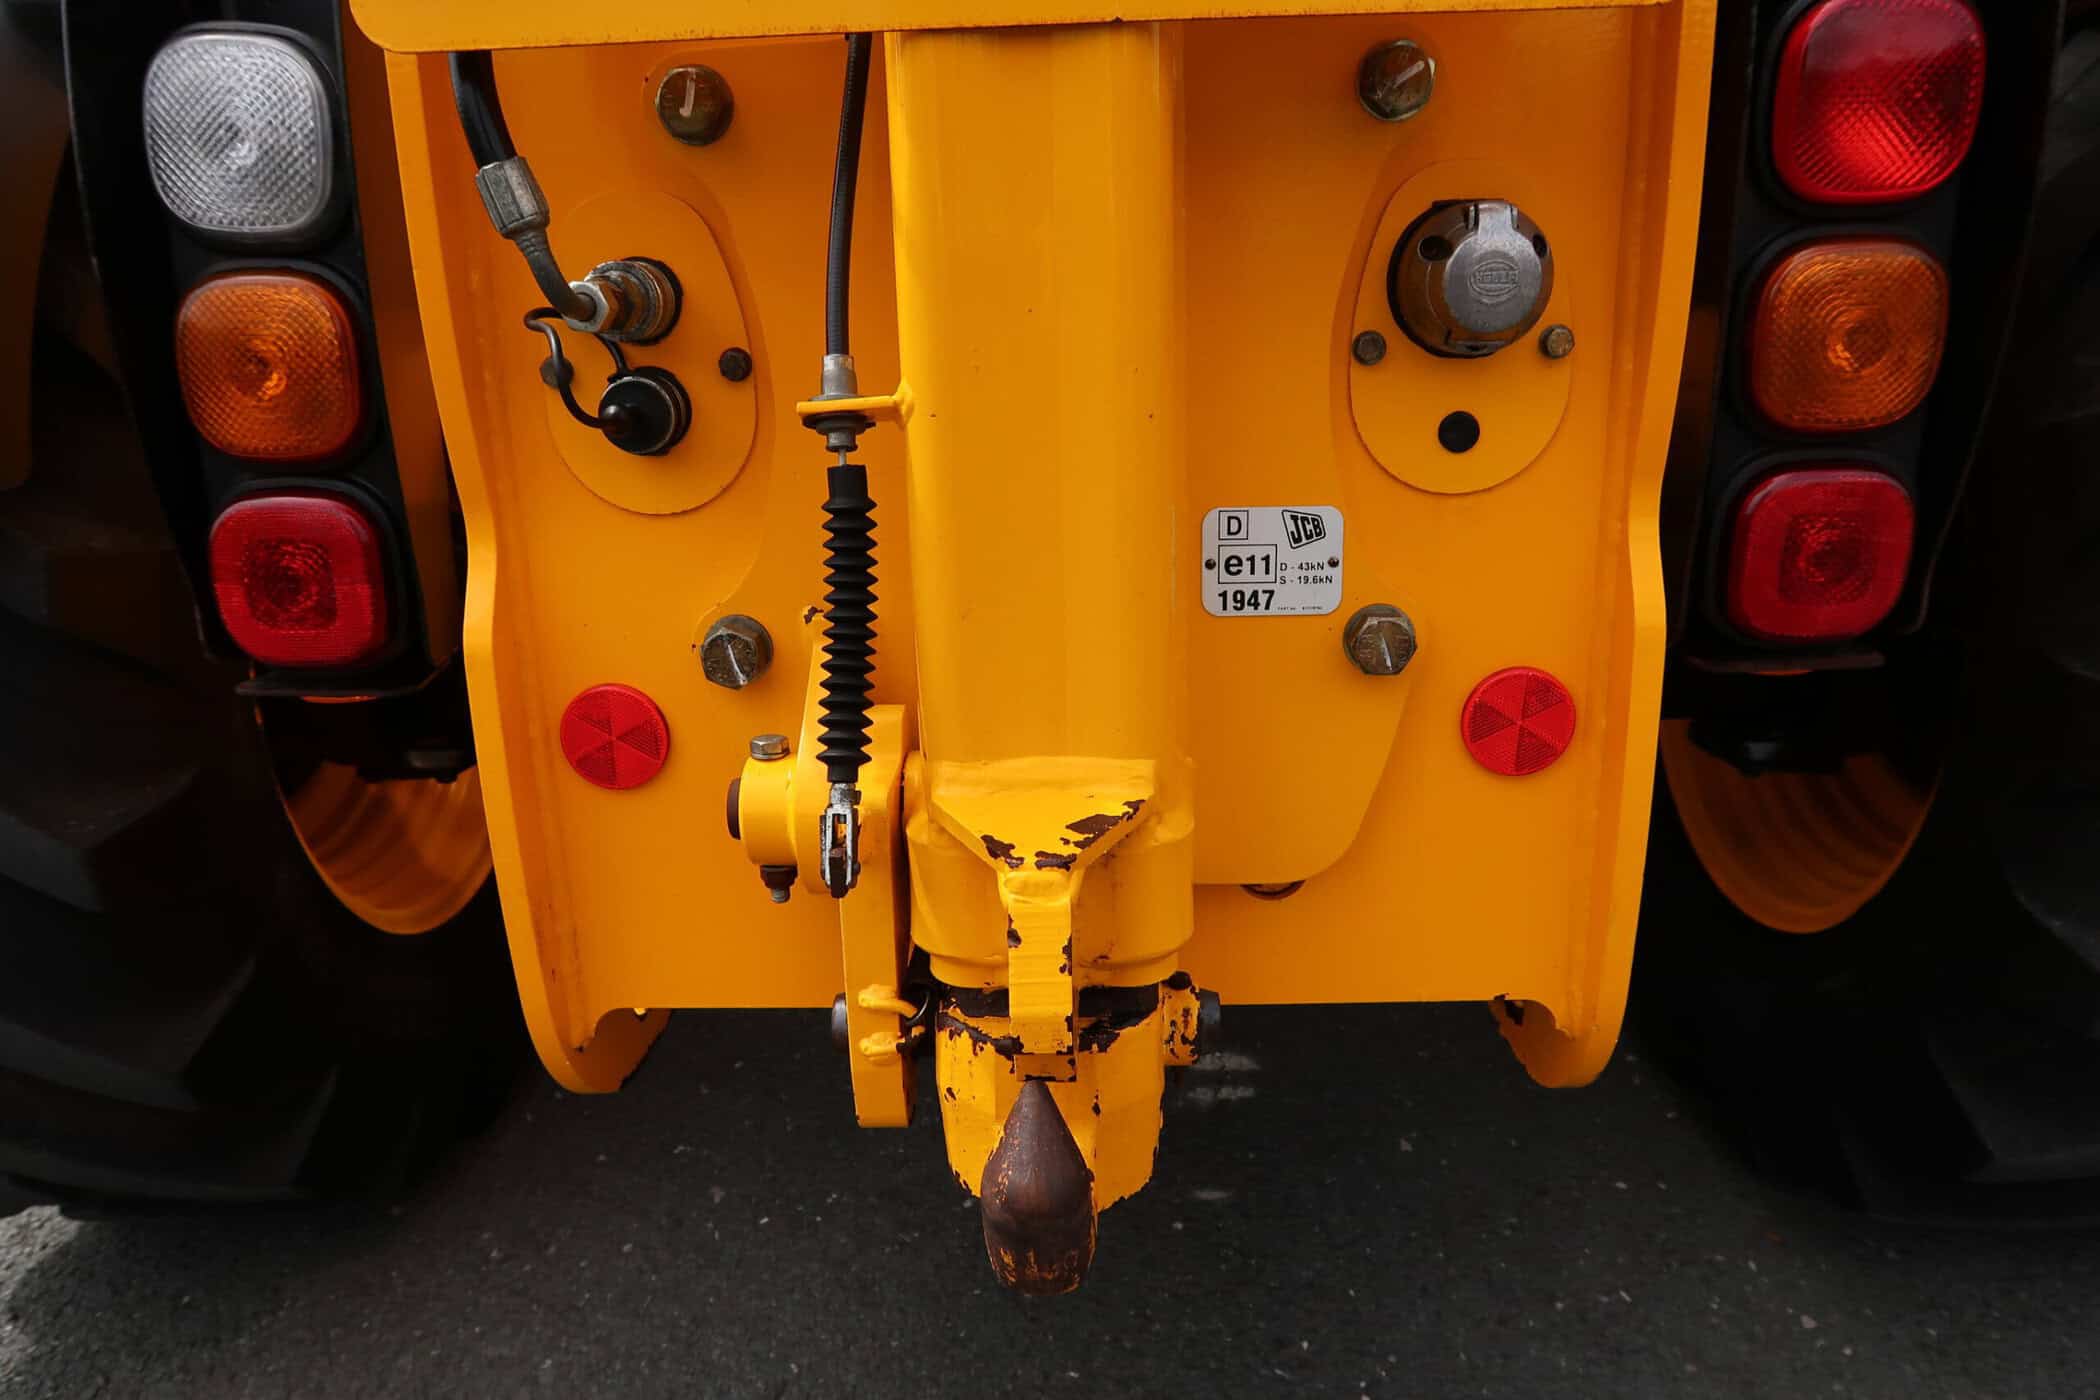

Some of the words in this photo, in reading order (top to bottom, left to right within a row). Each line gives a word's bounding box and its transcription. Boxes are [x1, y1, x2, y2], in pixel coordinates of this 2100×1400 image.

[1227, 515, 1242, 536] D
[1290, 514, 1324, 545] JCB
[1224, 554, 1271, 576] e11
[1280, 563, 1288, 571] D
[1297, 562, 1325, 571] 43kN
[1279, 576, 1287, 584] S
[1298, 575, 1333, 584] 19.6kN
[1218, 589, 1275, 611] 1947
